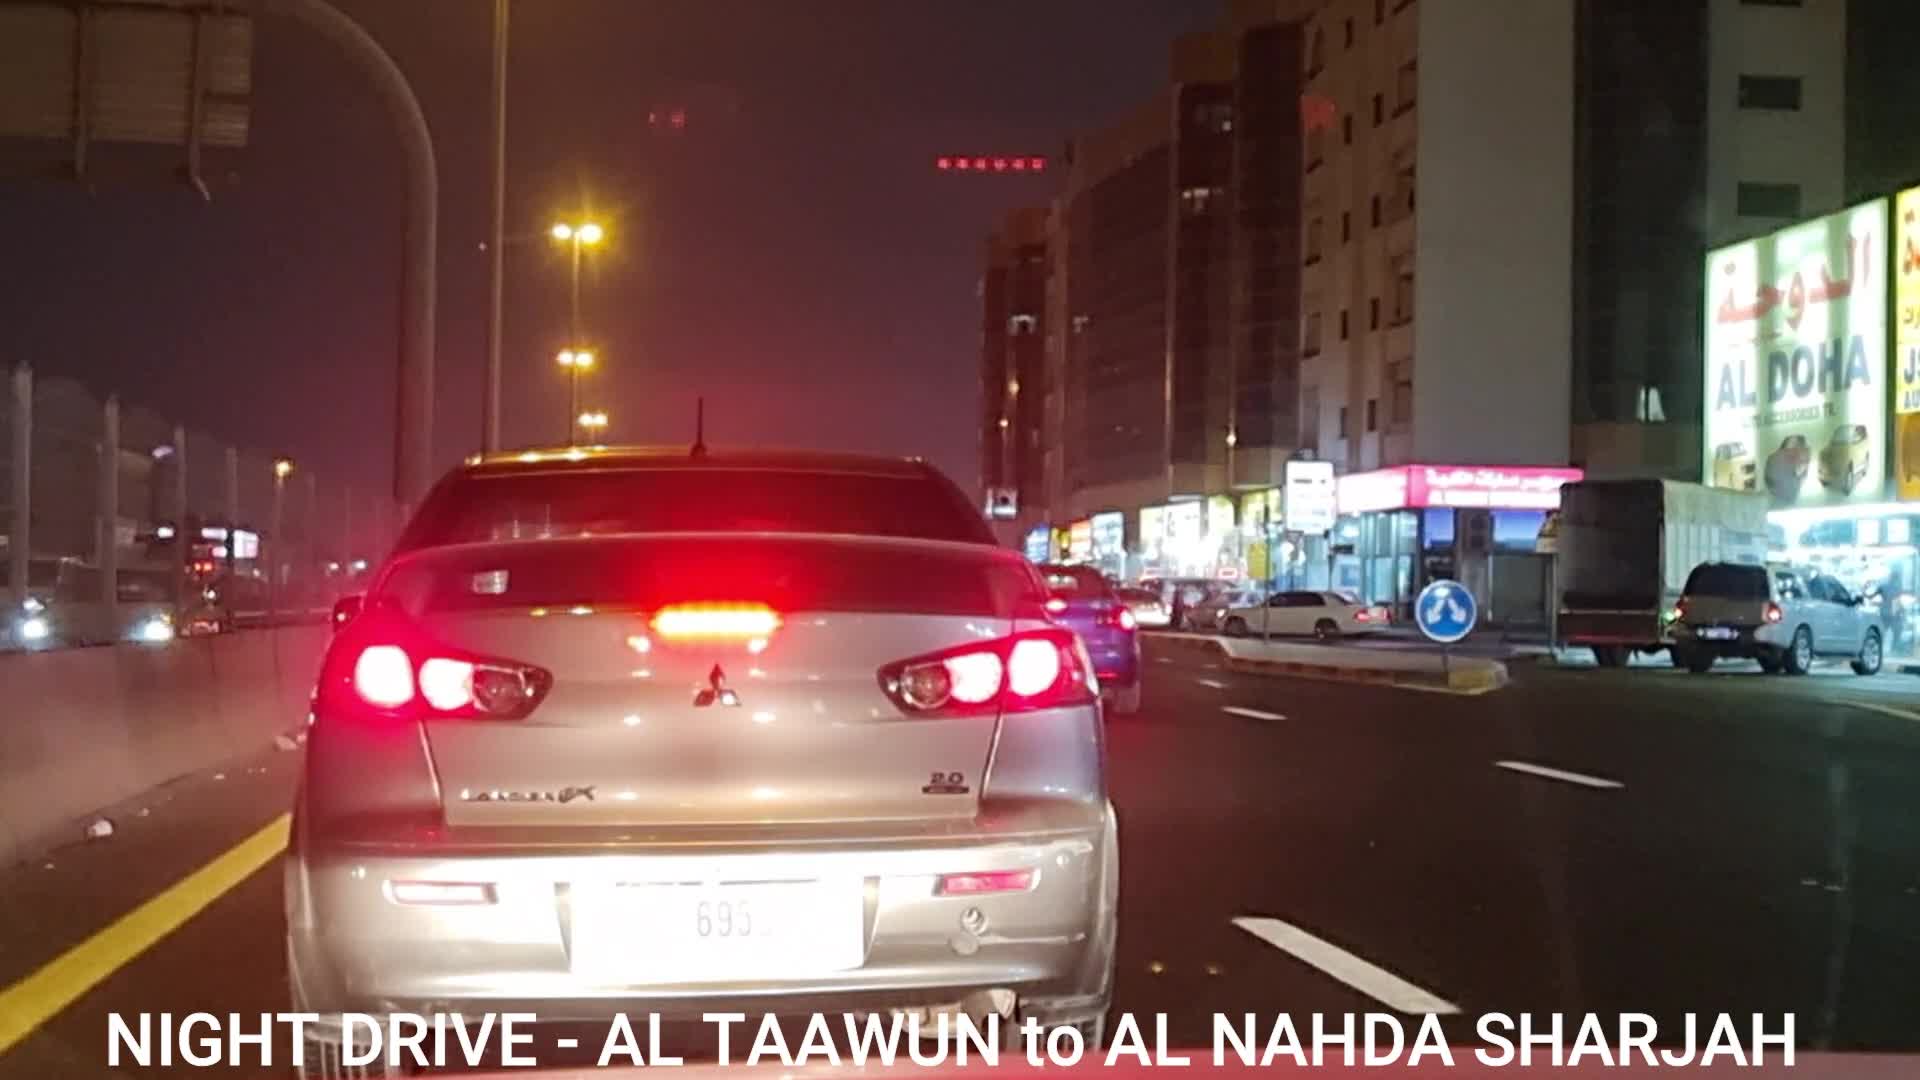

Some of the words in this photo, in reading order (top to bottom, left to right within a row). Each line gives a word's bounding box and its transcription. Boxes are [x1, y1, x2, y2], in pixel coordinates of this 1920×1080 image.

[1717, 231, 1871, 331] الدوحة
[1716, 360, 1758, 411] AL
[1768, 334, 1871, 403] DOHA
[929, 771, 965, 785] 2.0
